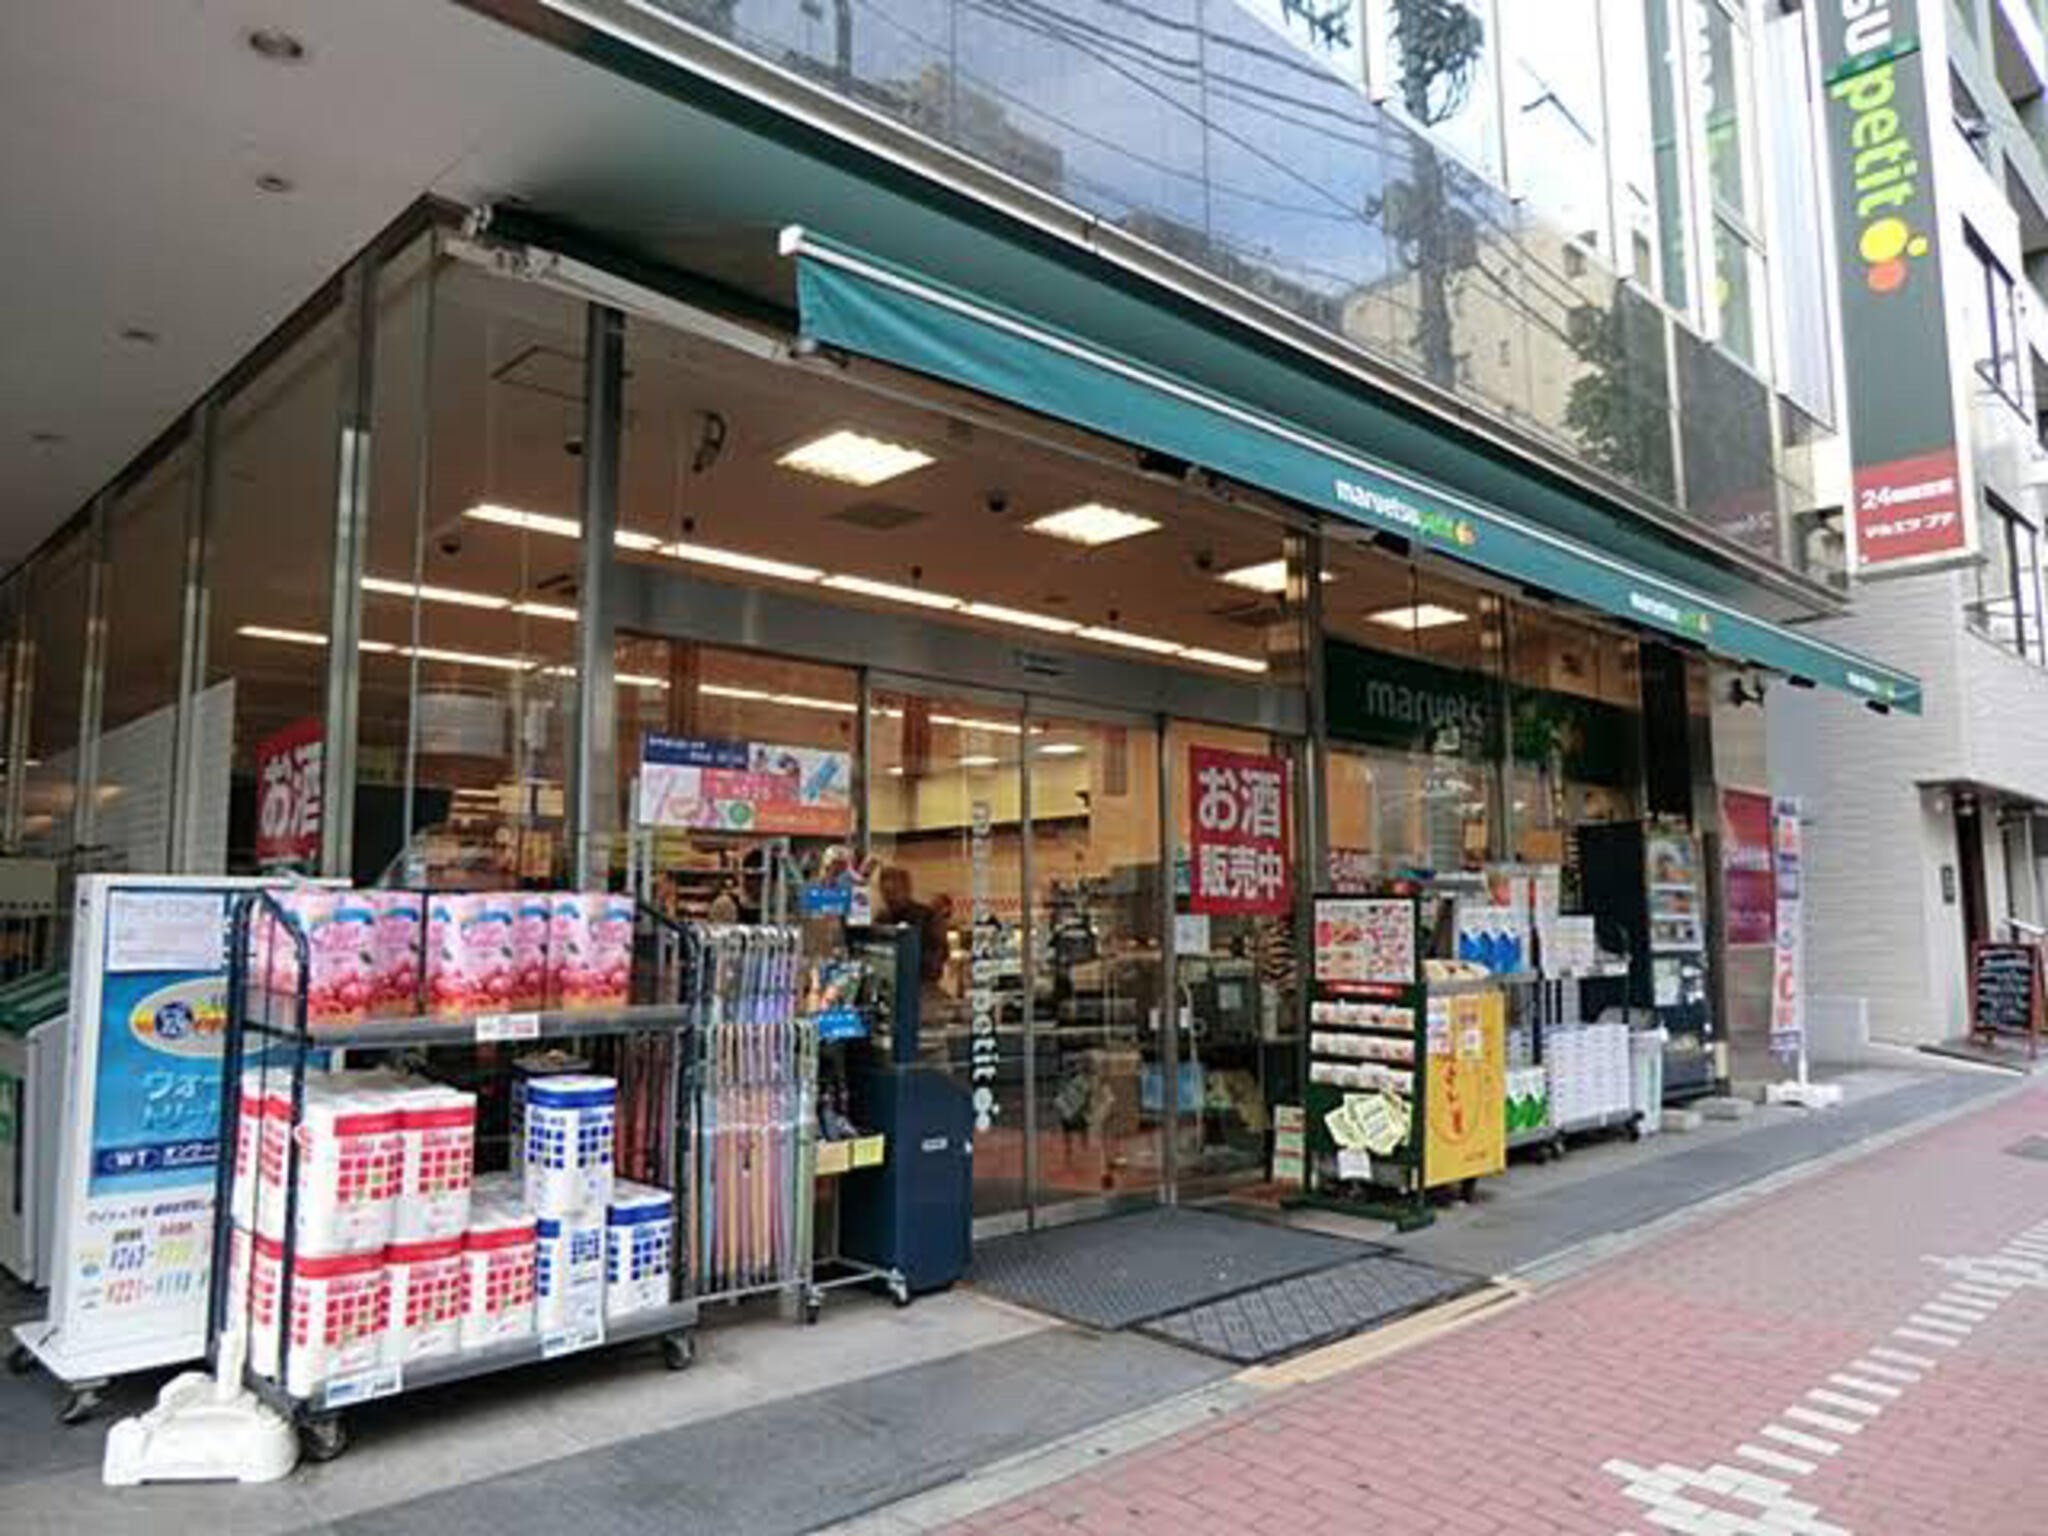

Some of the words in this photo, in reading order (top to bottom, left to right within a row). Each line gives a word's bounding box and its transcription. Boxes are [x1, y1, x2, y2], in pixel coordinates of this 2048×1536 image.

[1830, 61, 1918, 217] petit
[1198, 767, 1281, 839] お酒
[1200, 843, 1284, 901] 販売中
